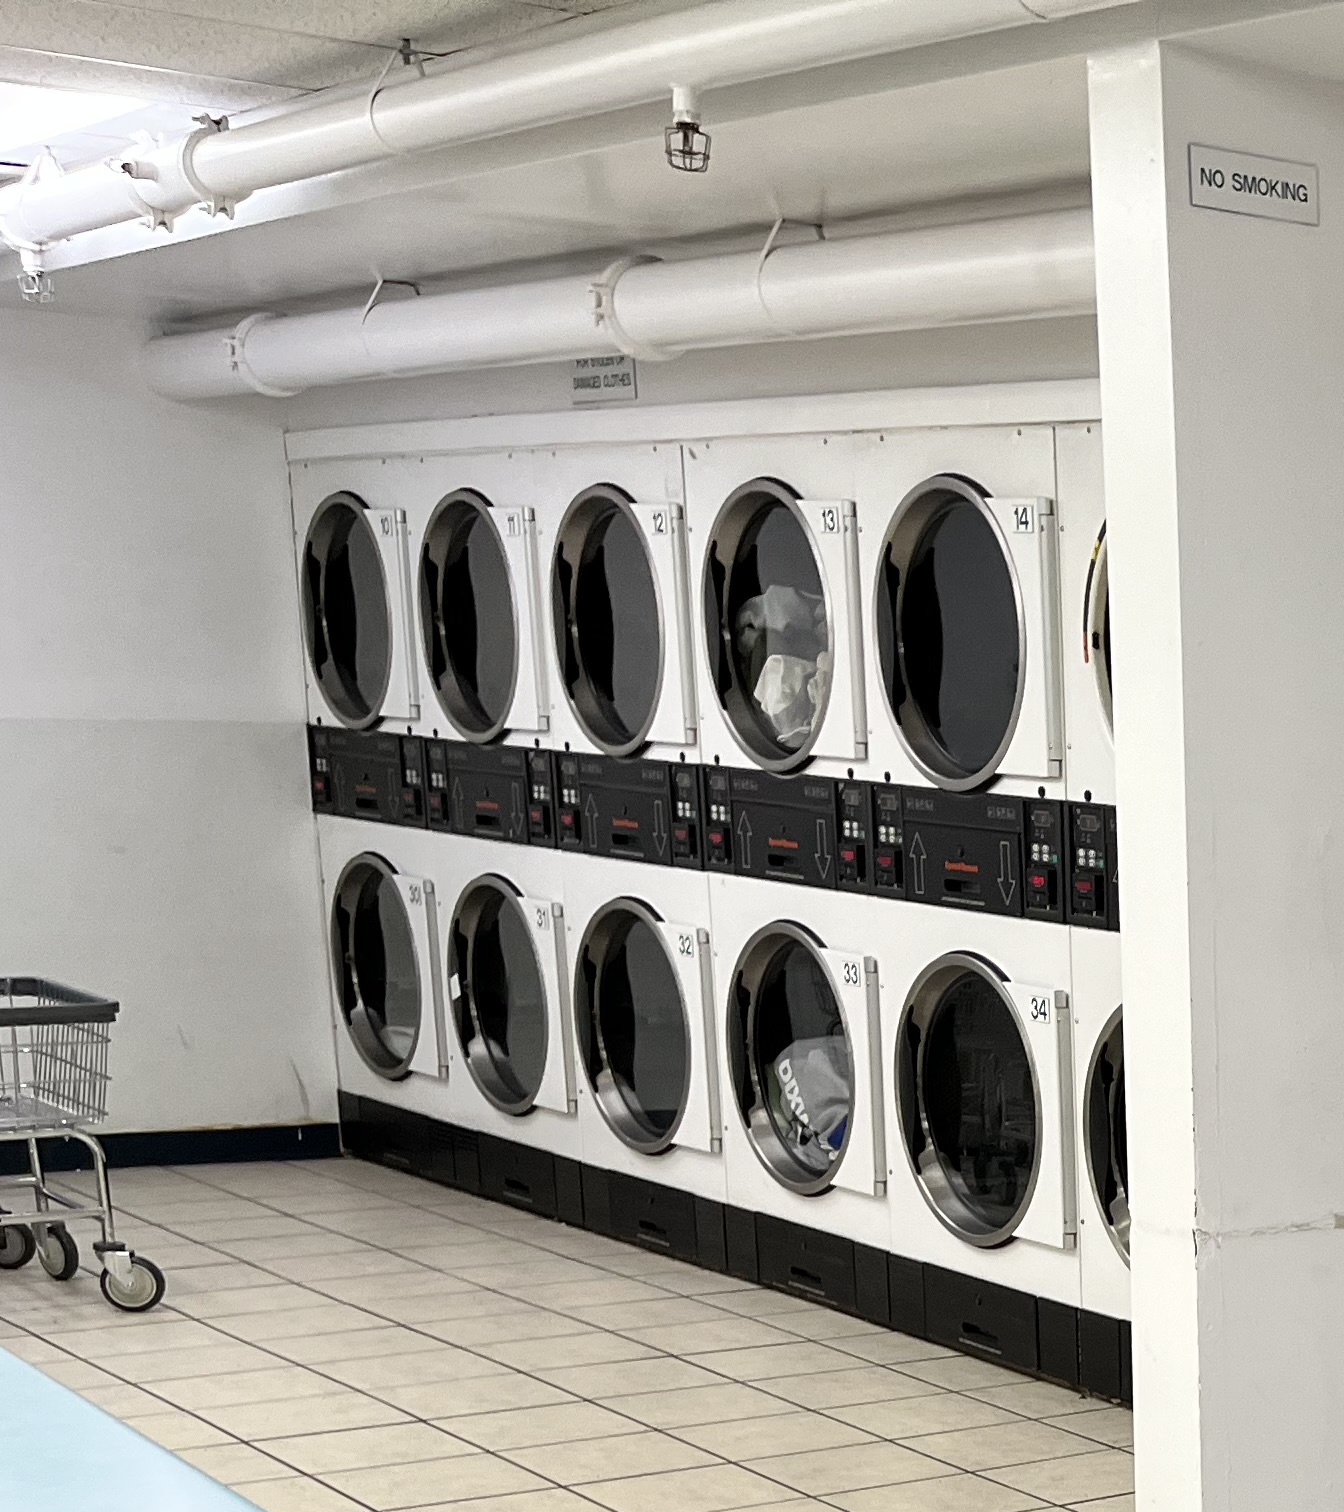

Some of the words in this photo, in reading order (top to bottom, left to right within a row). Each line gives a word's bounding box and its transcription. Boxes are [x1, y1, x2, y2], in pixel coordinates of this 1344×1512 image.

[1200, 167, 1225, 188] NO
[1232, 173, 1309, 203] SMOKING
[652, 512, 664, 533] 12
[822, 509, 836, 531] 13
[1014, 507, 1029, 530] 14
[679, 935, 692, 954] 32
[844, 963, 858, 984] 33
[1031, 997, 1047, 1021] 34
